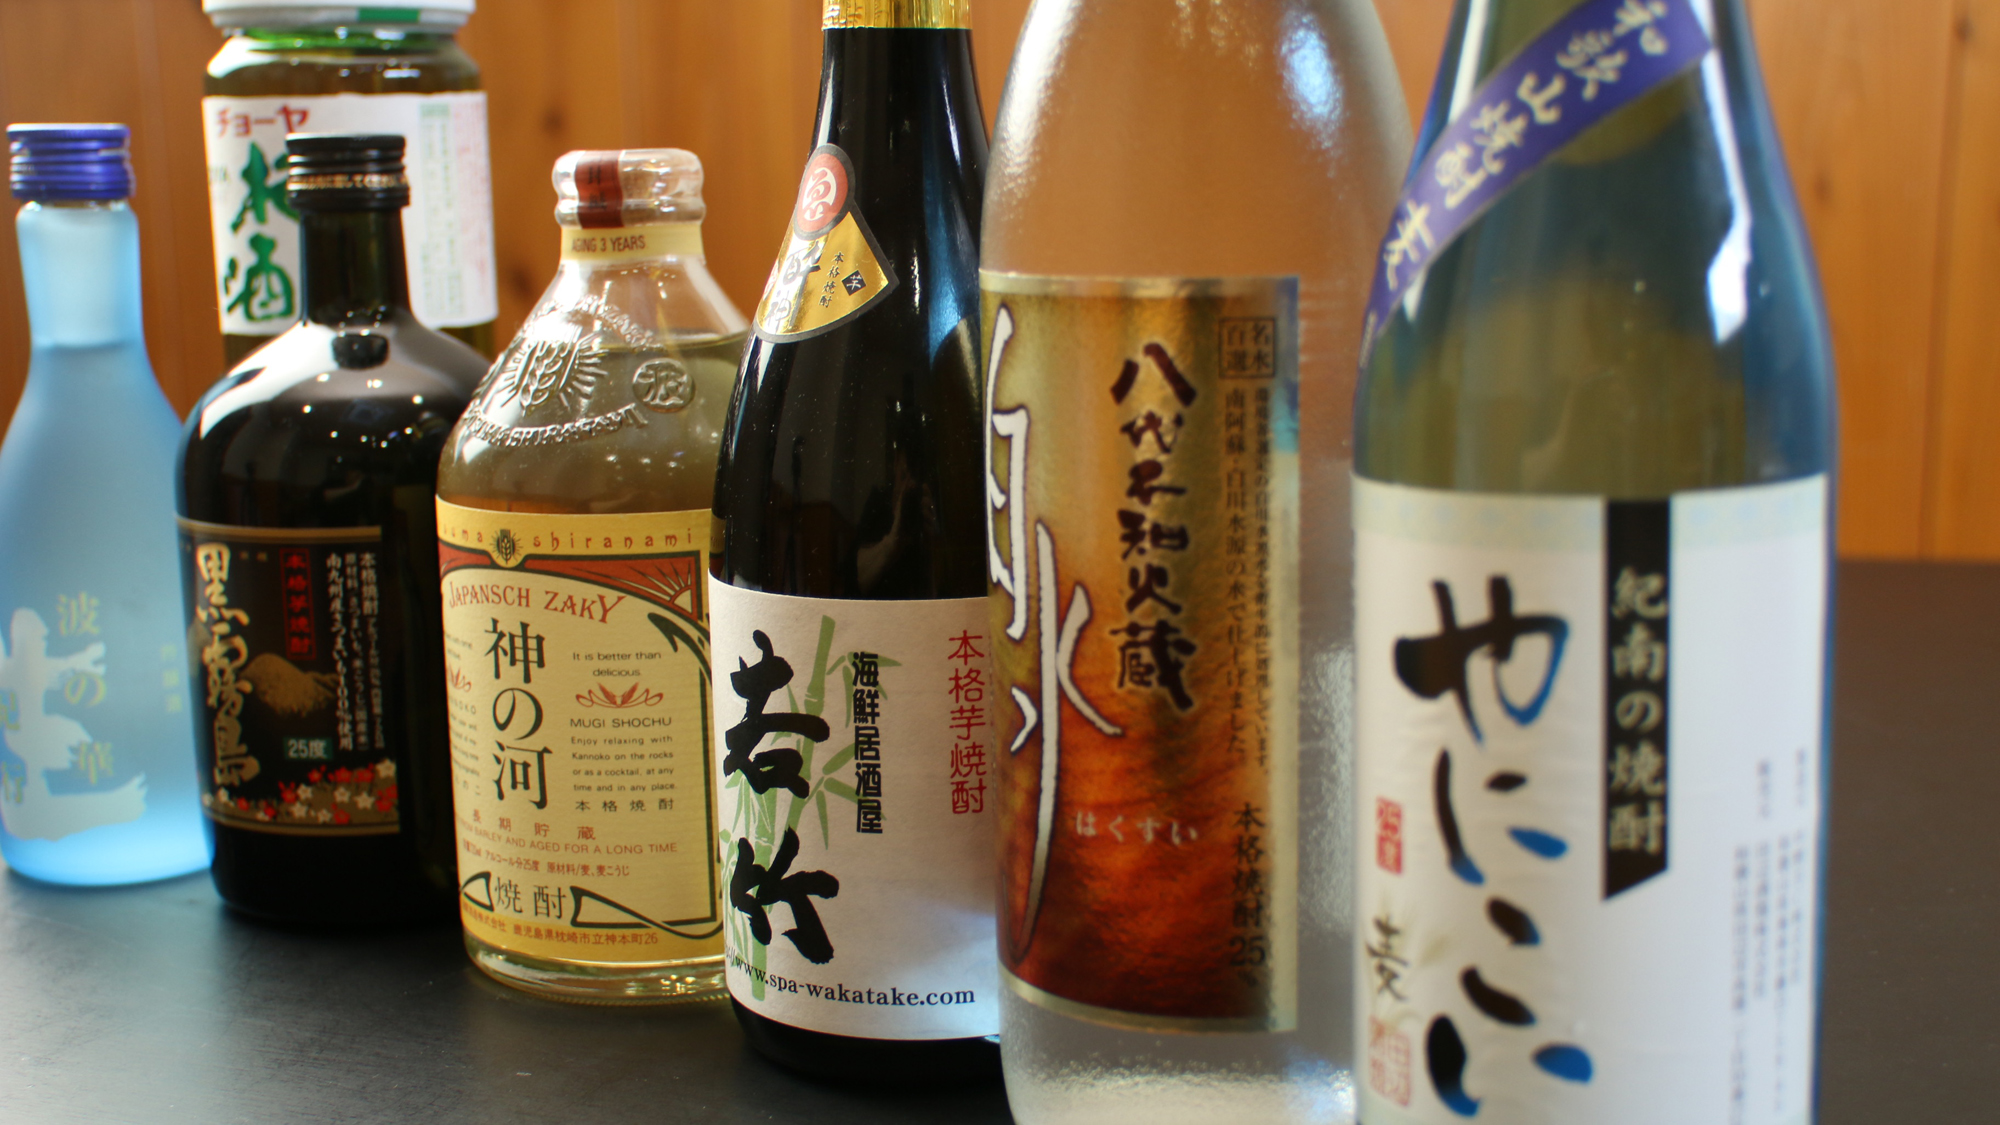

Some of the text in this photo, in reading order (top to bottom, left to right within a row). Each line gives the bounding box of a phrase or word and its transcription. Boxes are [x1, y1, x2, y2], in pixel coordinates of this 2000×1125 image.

[216, 104, 311, 138] チョーヤ
[572, 234, 647, 253] AGING 3 YEARS
[818, 251, 845, 308] 本格焼酎
[533, 528, 692, 551] shiranami
[449, 581, 628, 624] JAPANSCH ZAKY
[572, 651, 662, 661] It is better than
[484, 617, 553, 810] 神の河
[570, 716, 672, 728] MUGI SHOCHU
[947, 629, 988, 815] 本格芋焼酎
[1609, 567, 1668, 855] 紀南の焼酎
[287, 738, 328, 760] 25度
[571, 735, 673, 746] Enjoy relaxing with
[851, 650, 884, 835] 海鮮居酒屋
[572, 751, 674, 761] Kannoko on the rocks
[646, 767, 656, 775] at
[658, 767, 675, 777] any
[573, 783, 593, 792] time
[596, 783, 613, 792] and
[617, 783, 626, 792] in
[630, 784, 647, 793] any
[723, 629, 840, 965] 若竹
[575, 797, 674, 812] 本格焼酎
[472, 809, 597, 841] 長期貯蔵
[475, 824, 503, 843] BARLEY
[505, 835, 527, 848] AND
[529, 840, 561, 853] AGED
[564, 843, 590, 855] FOR
[593, 844, 602, 855] A
[606, 843, 644, 856] LONG
[648, 842, 678, 854] TIME
[1074, 810, 1198, 847] はくすい
[484, 849, 541, 873] アルコール分25度
[546, 860, 631, 878] 原材料/麦、麦こうじ
[494, 876, 567, 920] 焼酎
[513, 922, 659, 946] 鹿児島県枕崎市立神本町26
